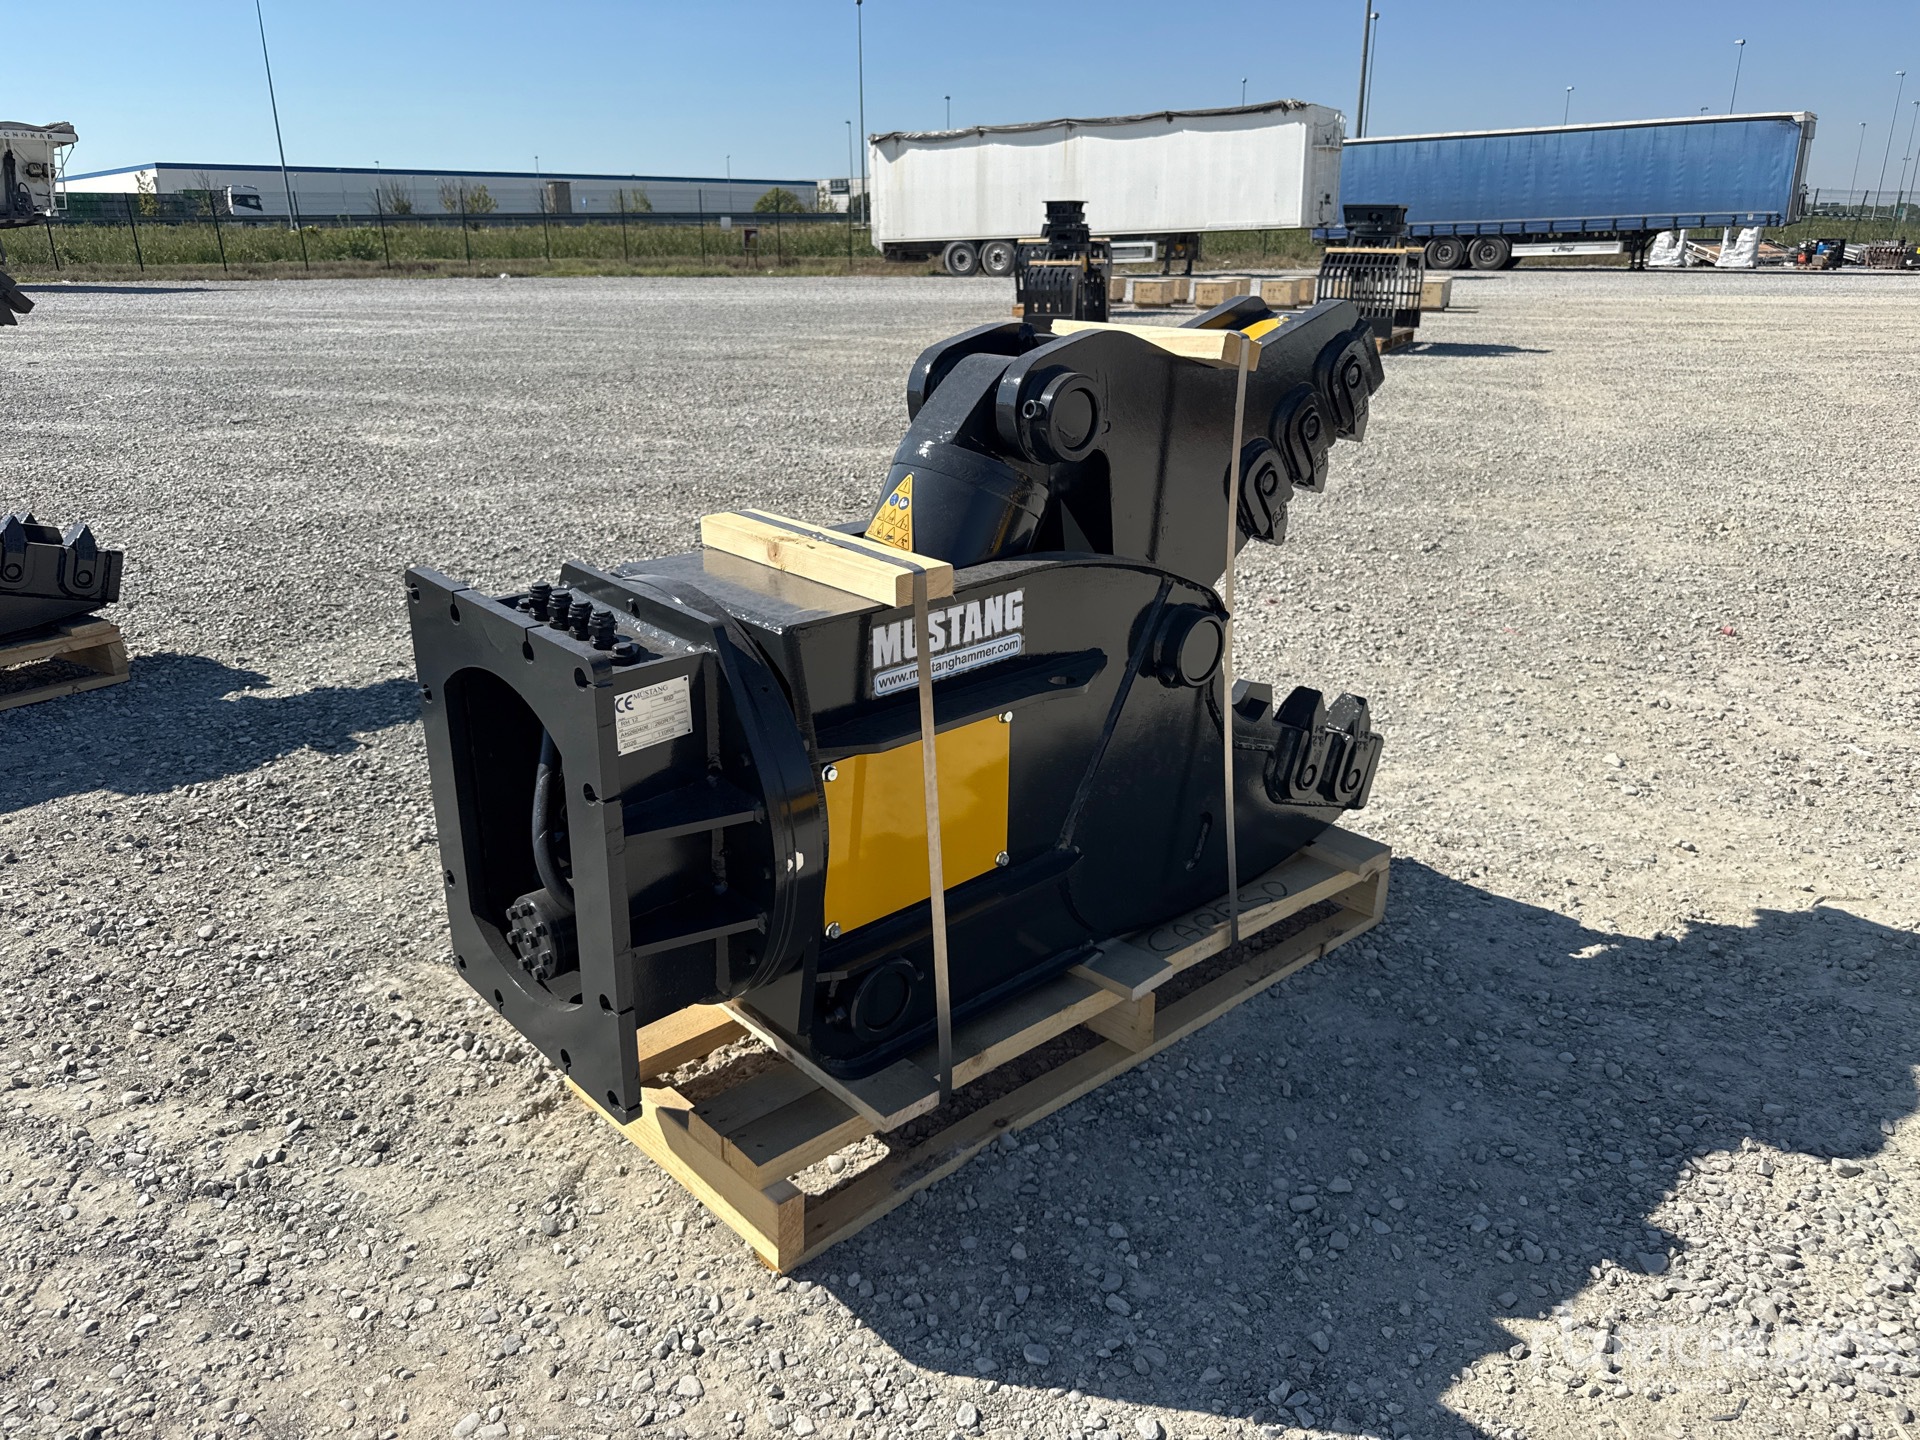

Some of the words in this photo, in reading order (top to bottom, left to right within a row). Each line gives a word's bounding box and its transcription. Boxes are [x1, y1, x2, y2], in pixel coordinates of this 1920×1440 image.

[0, 131, 53, 140] CNOKAR
[872, 590, 1024, 669] MUSTANG
[878, 638, 1019, 689] www.mtanghammer.com
